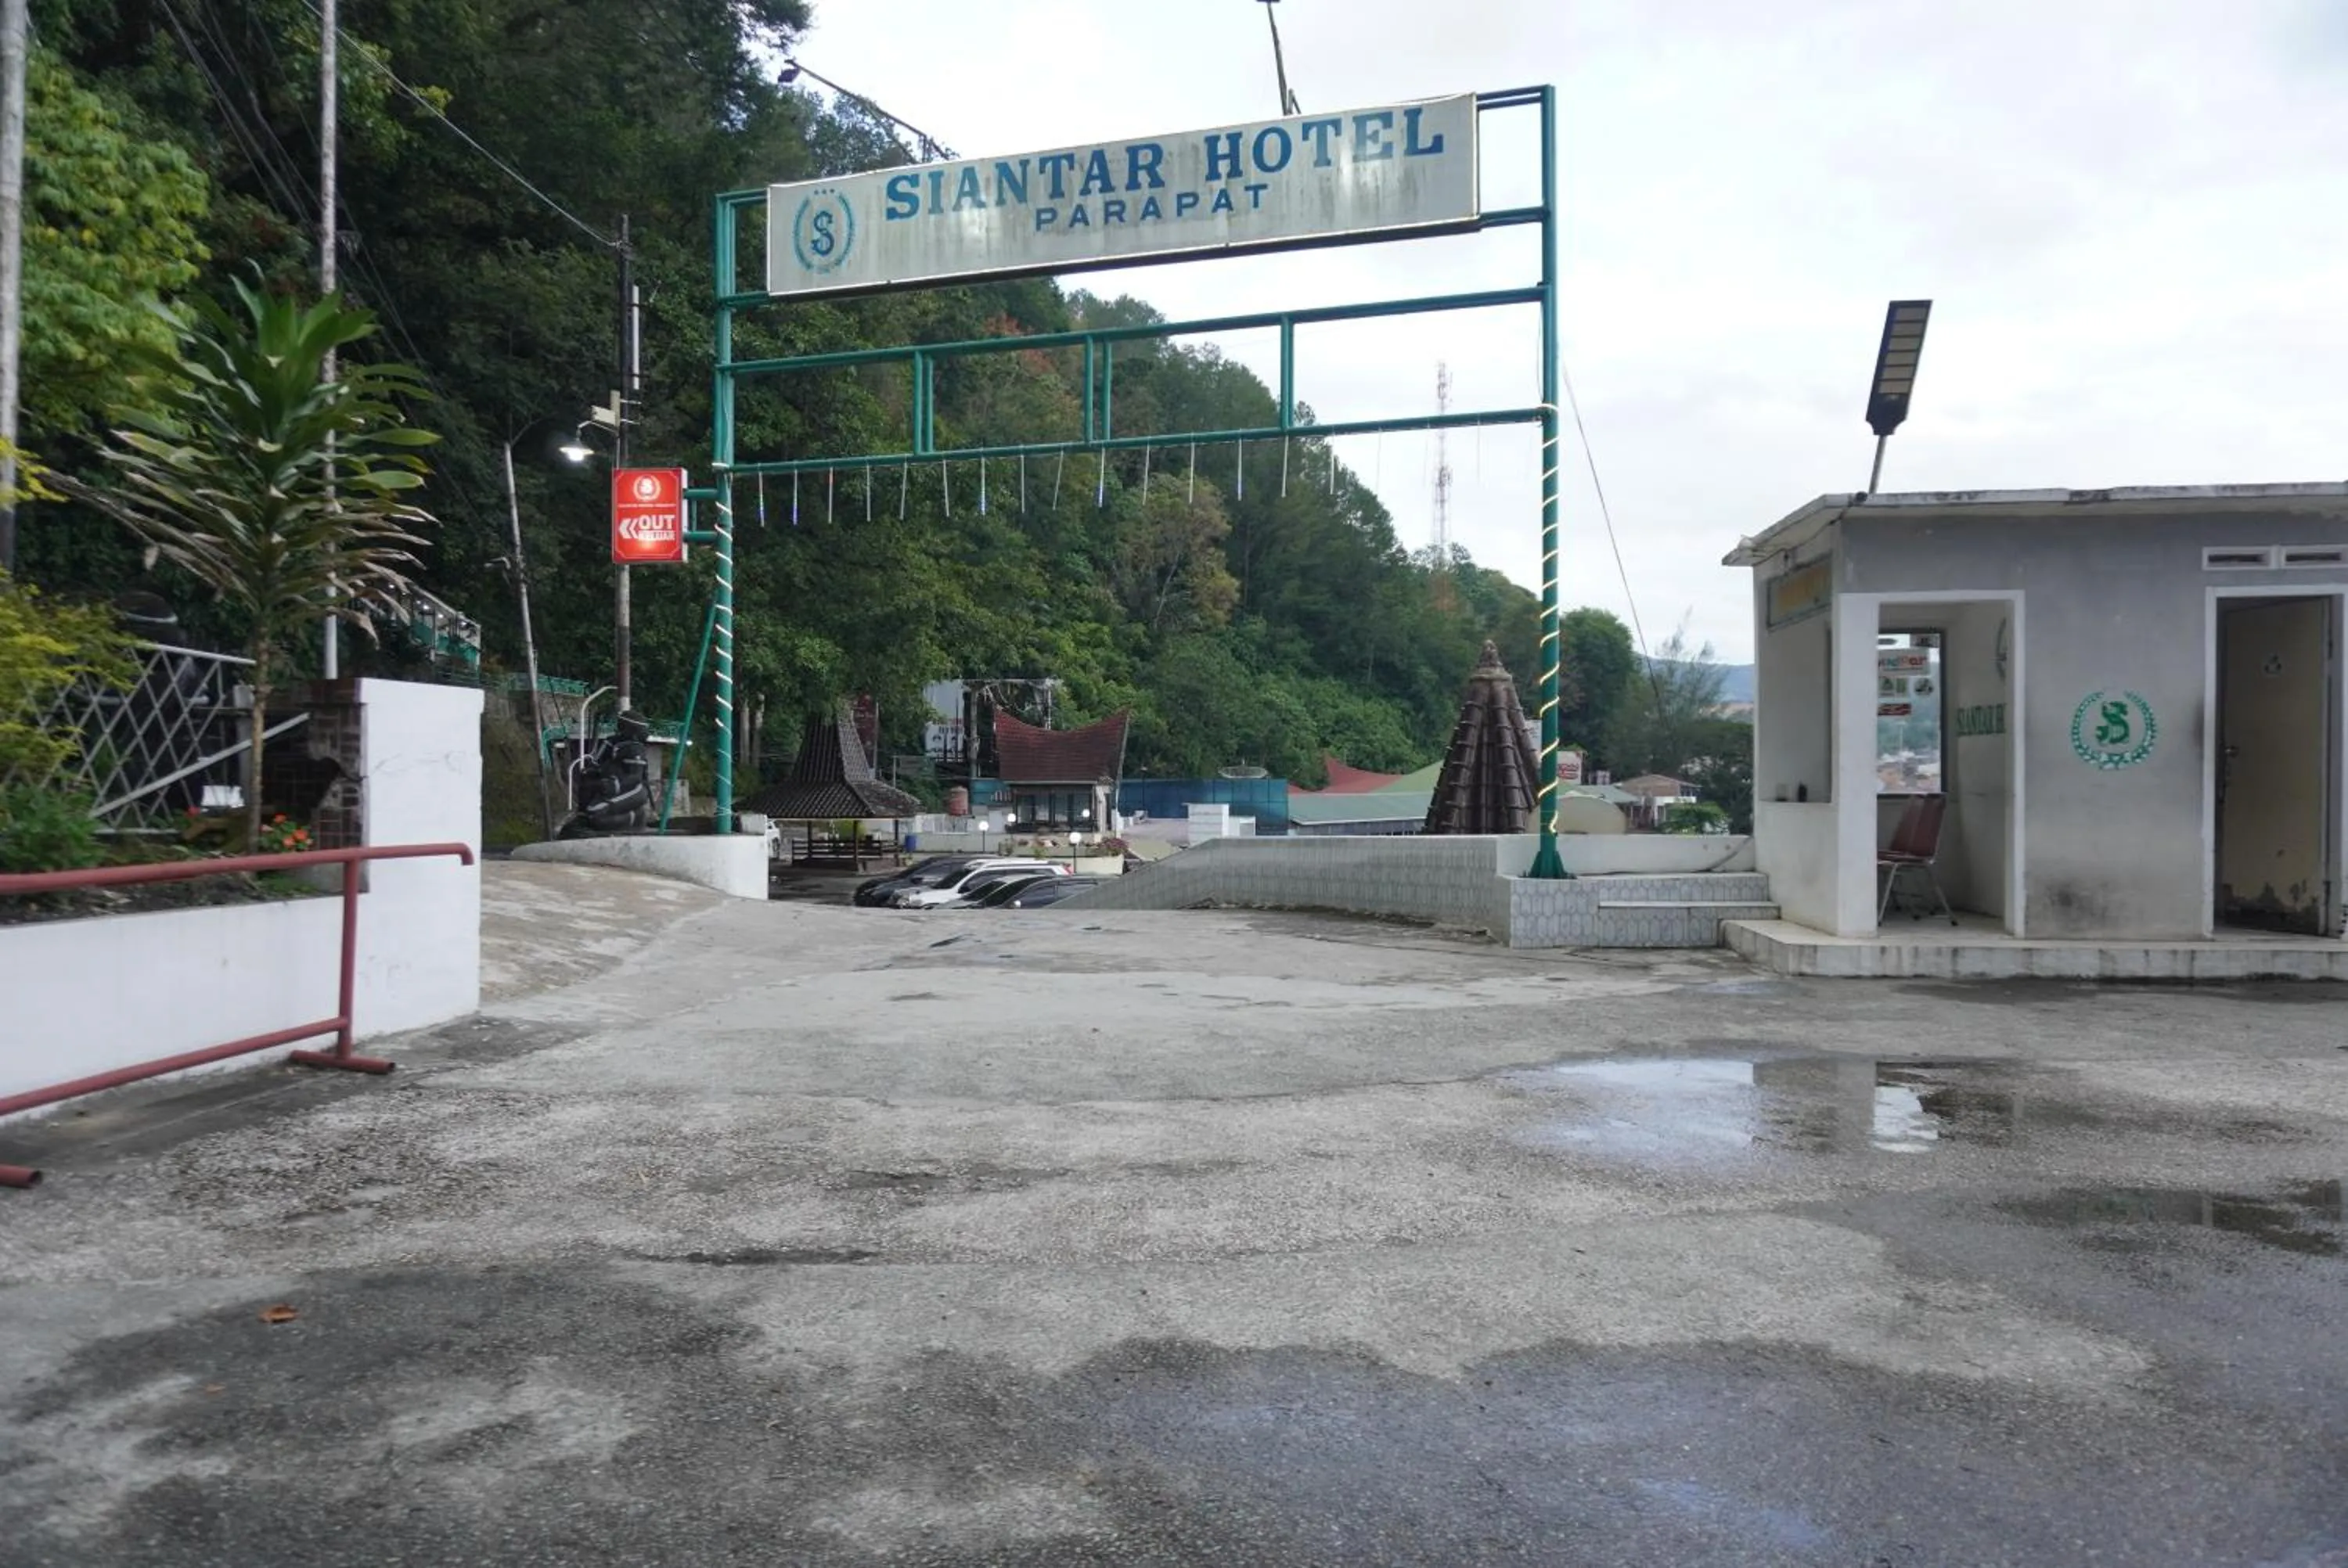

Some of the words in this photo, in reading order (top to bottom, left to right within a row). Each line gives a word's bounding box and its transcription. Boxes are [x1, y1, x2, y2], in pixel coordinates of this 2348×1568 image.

[885, 142, 1165, 221] SIANTAR
[1204, 107, 1443, 182] HOTEL
[1035, 183, 1269, 232] PARAPAT
[638, 514, 675, 529] OUT
